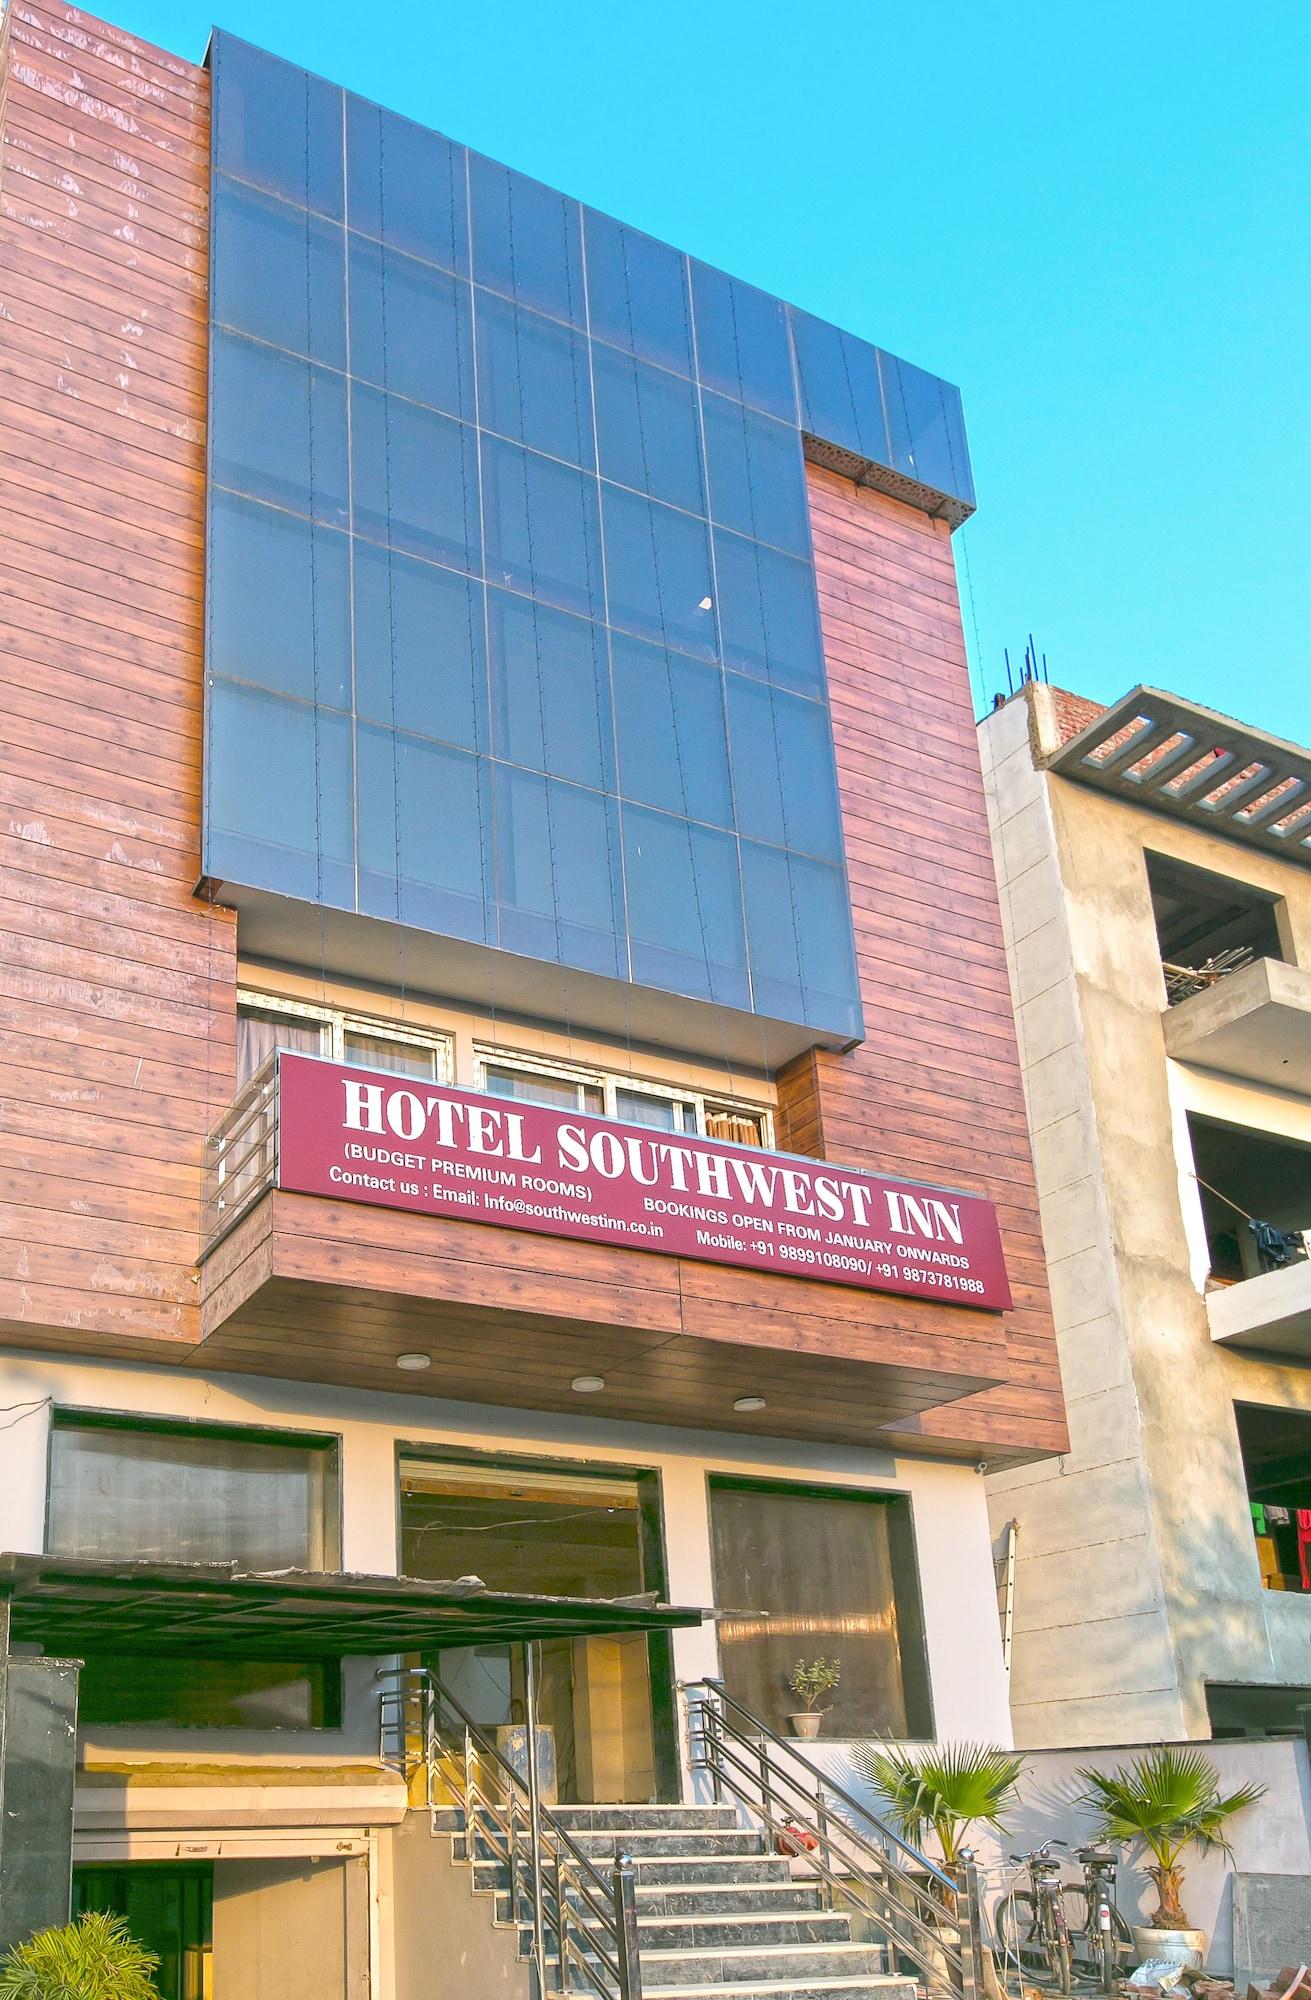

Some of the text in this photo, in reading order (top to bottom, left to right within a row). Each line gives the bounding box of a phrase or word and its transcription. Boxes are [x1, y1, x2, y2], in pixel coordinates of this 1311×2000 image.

[341, 1079, 964, 1245] HOTEL SOUTHWEST INN
[344, 1142, 592, 1202] (BUDGET PREMIUM ROOMS)
[329, 1166, 395, 1192] Contact
[399, 1181, 419, 1197] us
[433, 1184, 480, 1208] Email:
[484, 1193, 664, 1238] Info@southwestinn.co.in
[644, 1197, 969, 1270] BOOKINGS OPEN FROM JANUARY ONWARDS
[696, 1229, 985, 1294] Mobile: +91 9899108090/ +91 9873781988
